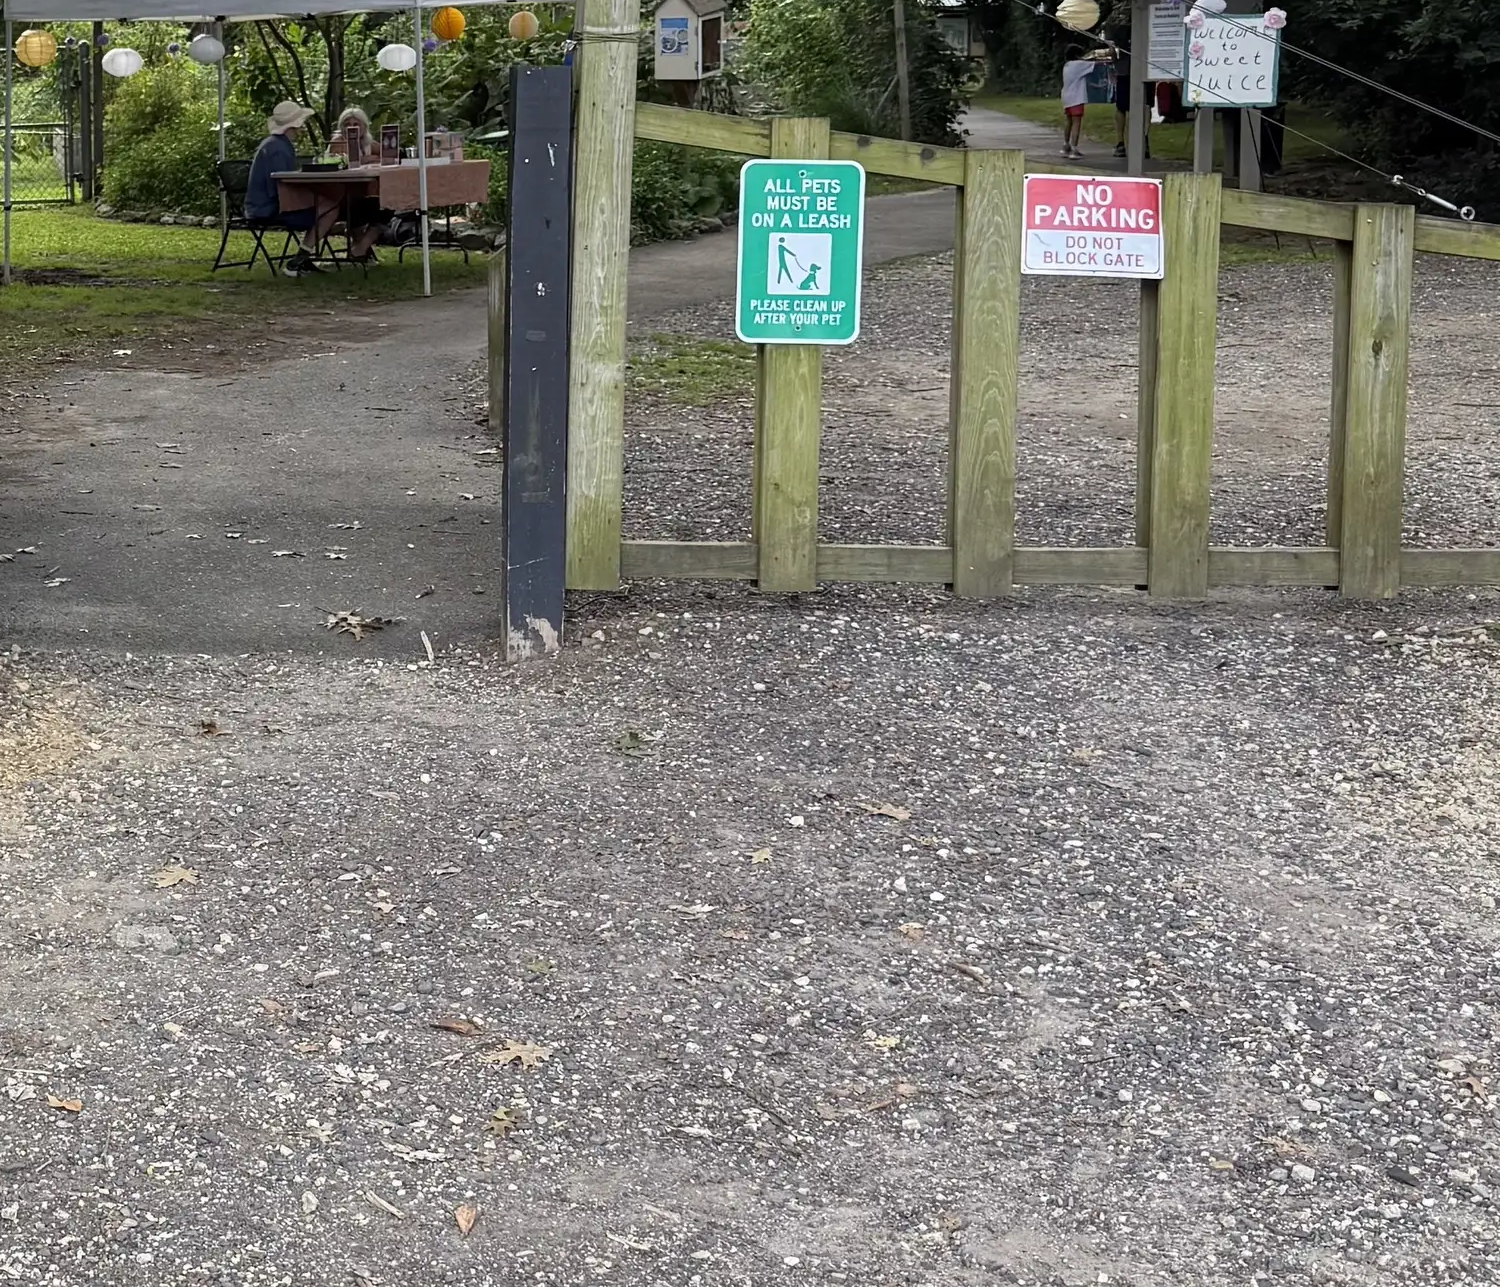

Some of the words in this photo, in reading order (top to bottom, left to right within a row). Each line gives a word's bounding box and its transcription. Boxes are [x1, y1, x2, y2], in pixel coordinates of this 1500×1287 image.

[1222, 41, 1238, 51] to
[763, 178, 796, 194] ALL
[801, 178, 842, 194] PETS
[1076, 183, 1113, 206] NO
[766, 195, 811, 211] MUST
[816, 196, 838, 212] BE
[751, 212, 775, 228] ON
[779, 212, 793, 228] A
[798, 213, 852, 229] LEASH
[1034, 204, 1155, 230] PARKING
[1065, 235, 1088, 249] DO
[1092, 236, 1124, 251] NOT
[1043, 250, 1099, 266] BLOCK
[1103, 252, 1145, 268] GATE
[749, 299, 791, 311] PLEASE
[793, 299, 828, 312] CLEAN
[831, 300, 847, 312] UP
[753, 312, 786, 324] AFTER
[790, 313, 819, 325] YOUR
[821, 314, 842, 326] PET
